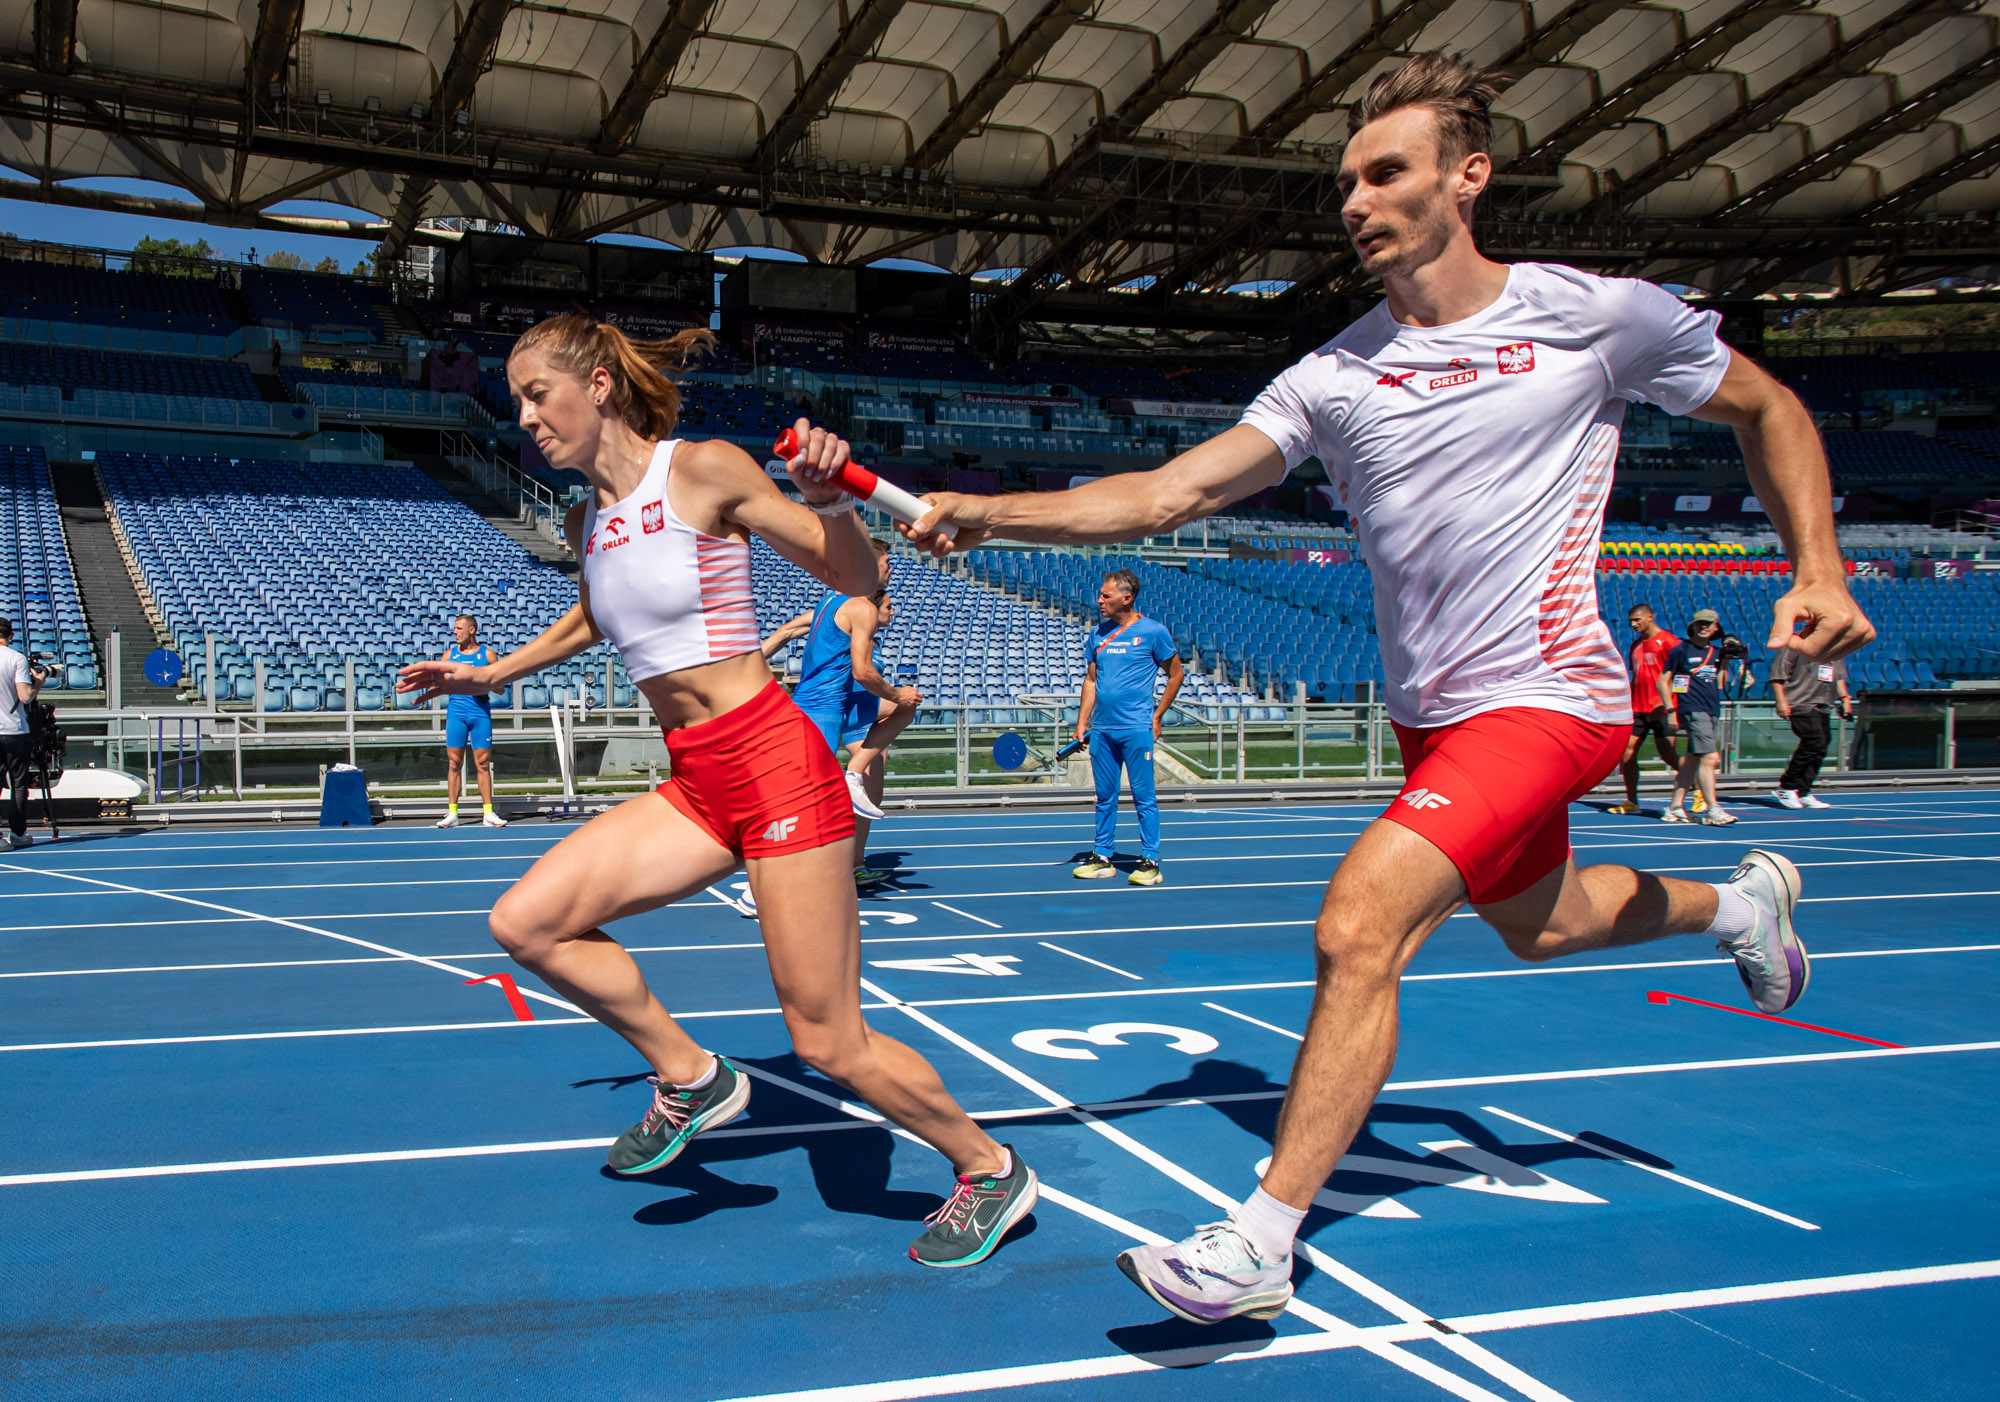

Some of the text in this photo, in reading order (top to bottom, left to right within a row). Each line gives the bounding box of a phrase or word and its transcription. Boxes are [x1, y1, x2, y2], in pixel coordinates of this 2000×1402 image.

[1431, 372, 1475, 389] ORLEN
[1187, 407, 1228, 416] EUROPEAN
[602, 535, 630, 551] ORLEN
[1400, 788, 1452, 810] 4F
[762, 816, 799, 842] 4F
[868, 953, 1023, 976] 4
[1011, 1022, 1220, 1061] 3
